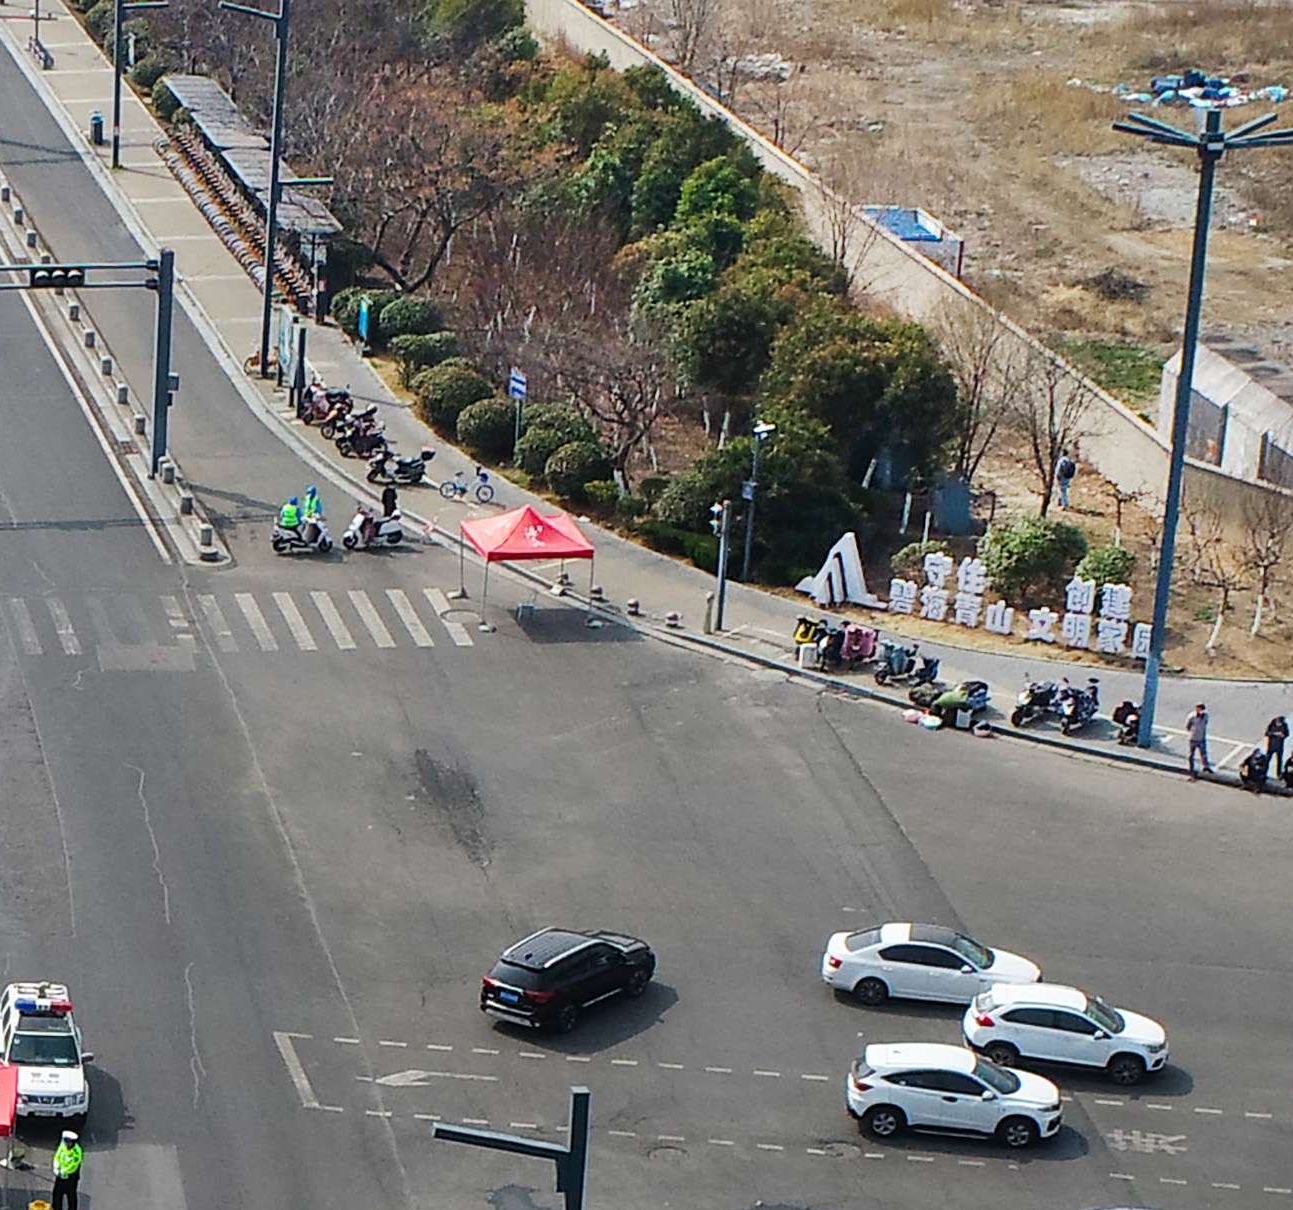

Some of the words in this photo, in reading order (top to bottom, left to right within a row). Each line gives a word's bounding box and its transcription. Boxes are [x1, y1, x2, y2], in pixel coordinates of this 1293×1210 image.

[923, 551, 987, 595] 守住
[890, 579, 1014, 635] 碧海青山
[1065, 576, 1133, 621] 创建
